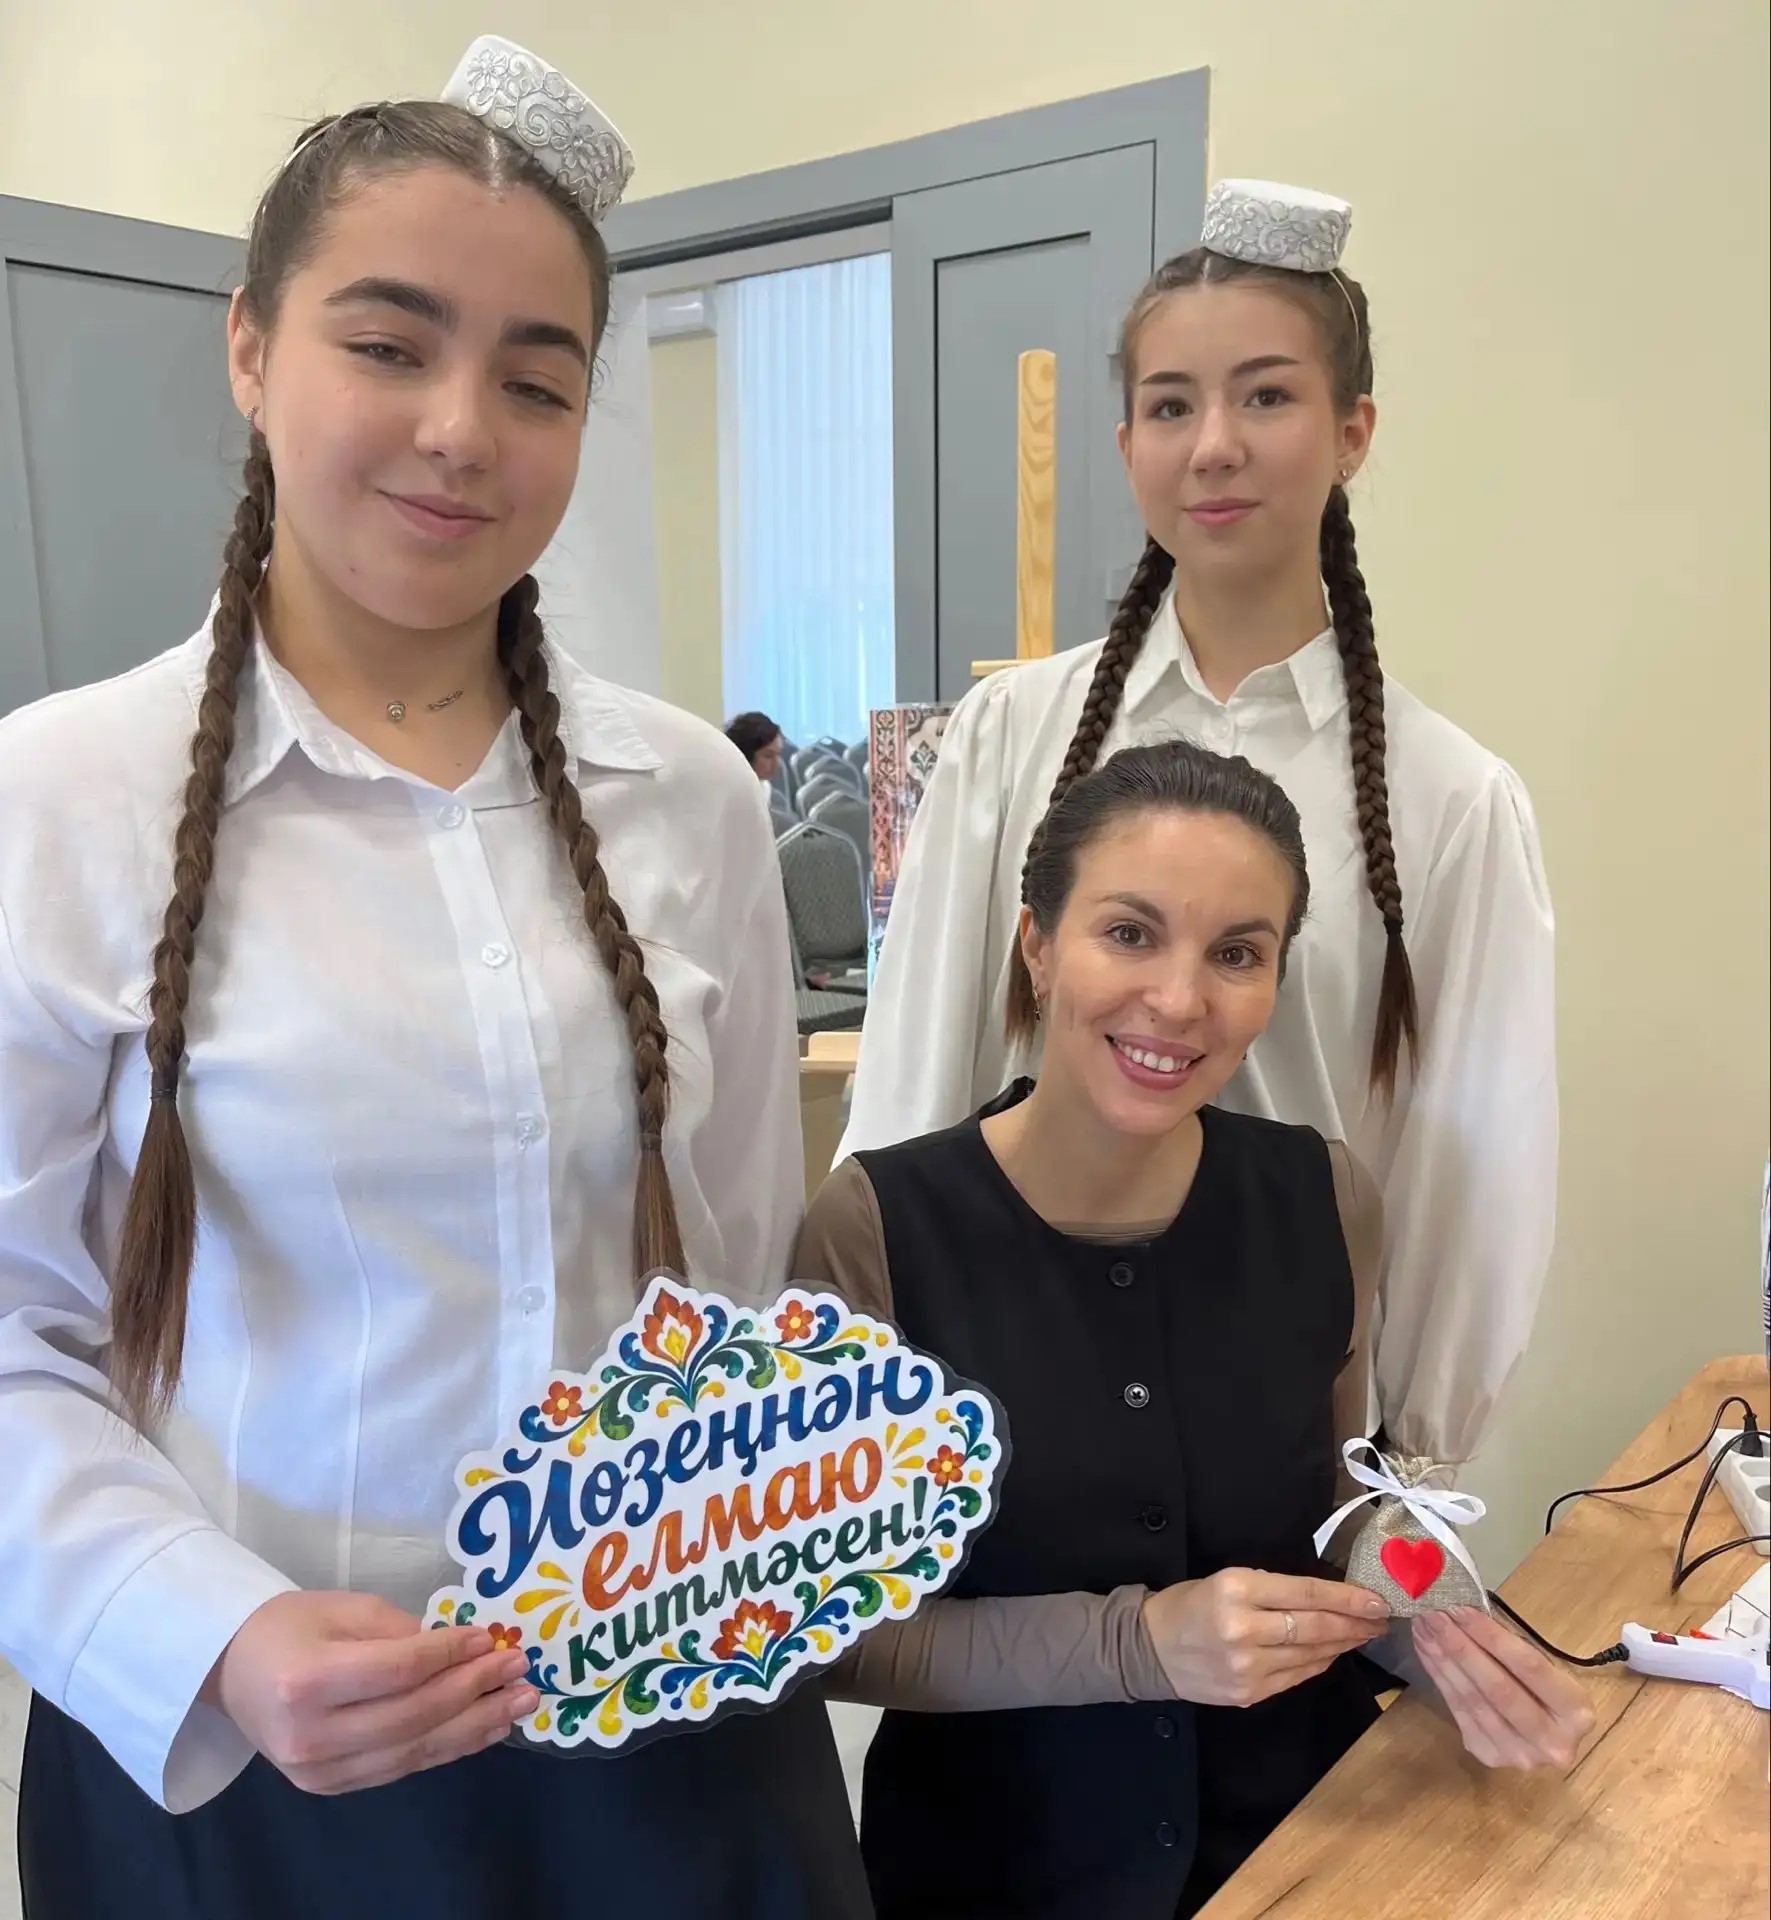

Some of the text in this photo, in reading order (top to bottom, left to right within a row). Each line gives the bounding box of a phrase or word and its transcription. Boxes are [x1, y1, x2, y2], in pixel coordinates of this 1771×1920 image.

[458, 1356, 932, 1598] Йөзеңнән
[567, 1476, 928, 1685] китмәсен!
[581, 1437, 882, 1611] елмаю
